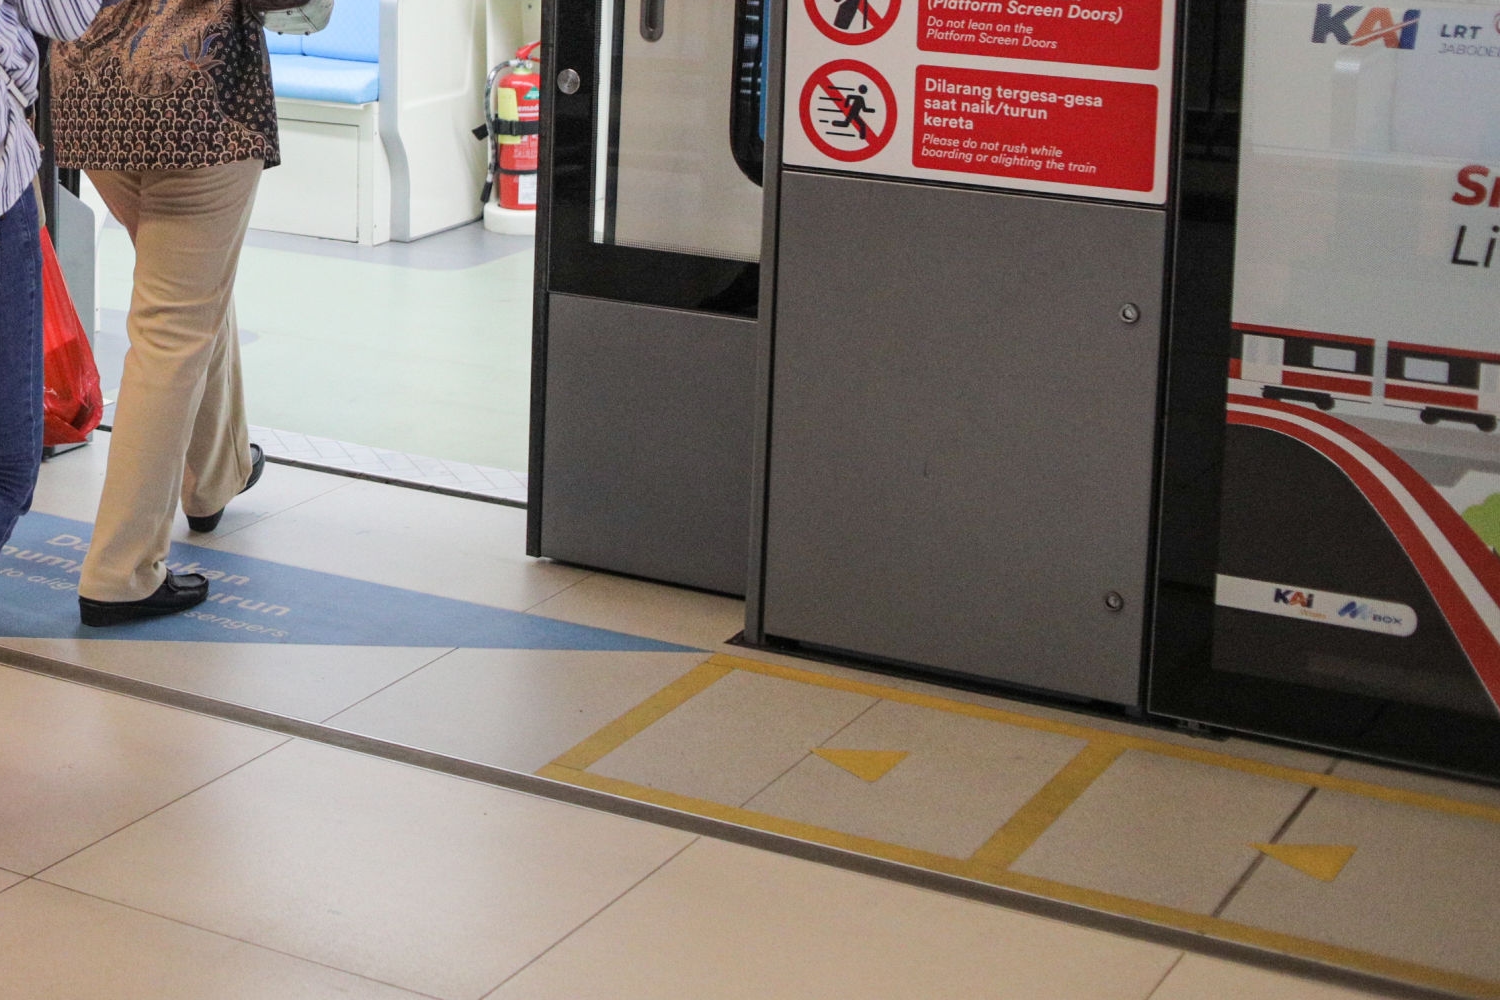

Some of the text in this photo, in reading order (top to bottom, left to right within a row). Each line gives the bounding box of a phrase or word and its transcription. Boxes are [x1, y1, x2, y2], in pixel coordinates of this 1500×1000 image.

[1006, 0, 1063, 18] Screen
[1068, 5, 1123, 24] Doors)
[927, 16, 1033, 34] Do not lean on the
[1311, 3, 1422, 50] KAI
[1440, 24, 1483, 39] LRT
[927, 29, 1058, 49] Platform Screen Doors
[925, 77, 1103, 107] Dilarang tergesa-gesa
[924, 98, 1047, 119] saat naik/turun
[923, 112, 974, 130] kereta
[922, 133, 1063, 158] Please do not rush while
[921, 146, 1097, 174] boarding or alighting the train
[1452, 165, 1500, 208] S
[1274, 588, 1315, 608] KAI
[183, 610, 289, 638] sengers
